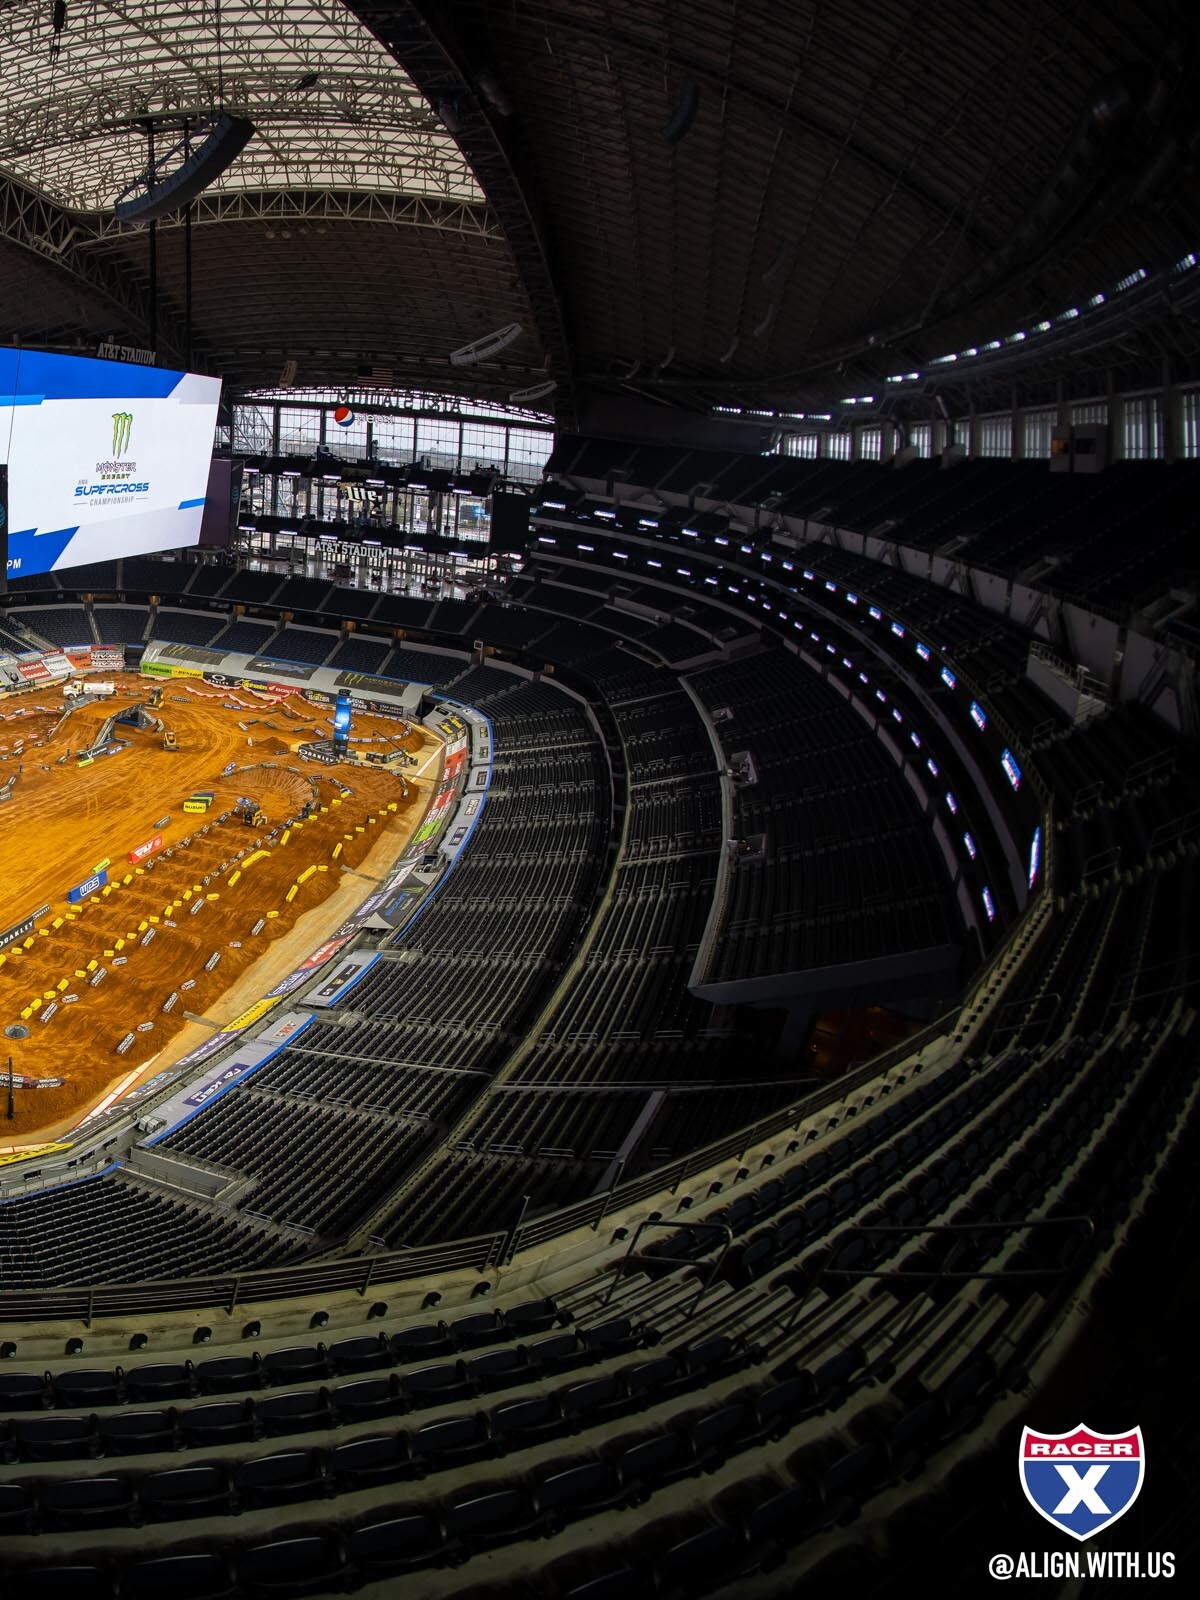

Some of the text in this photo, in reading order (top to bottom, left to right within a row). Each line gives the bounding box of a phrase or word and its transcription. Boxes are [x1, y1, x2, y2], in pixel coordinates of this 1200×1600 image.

[97, 342, 156, 366] AT&T STADIUM
[356, 414, 393, 427] pepsi
[96, 460, 136, 475] MONSTER
[74, 482, 150, 497] SUPERCROSS
[346, 485, 379, 502] Lite
[89, 495, 134, 507] CHAMPIONSHIP
[314, 541, 388, 558] AT&T STADIUM
[6, 558, 22, 570] PM
[308, 750, 334, 763] OAKLEY
[134, 840, 154, 857] FLY
[80, 876, 100, 897] WPS
[4, 920, 34, 945] OAKLEY
